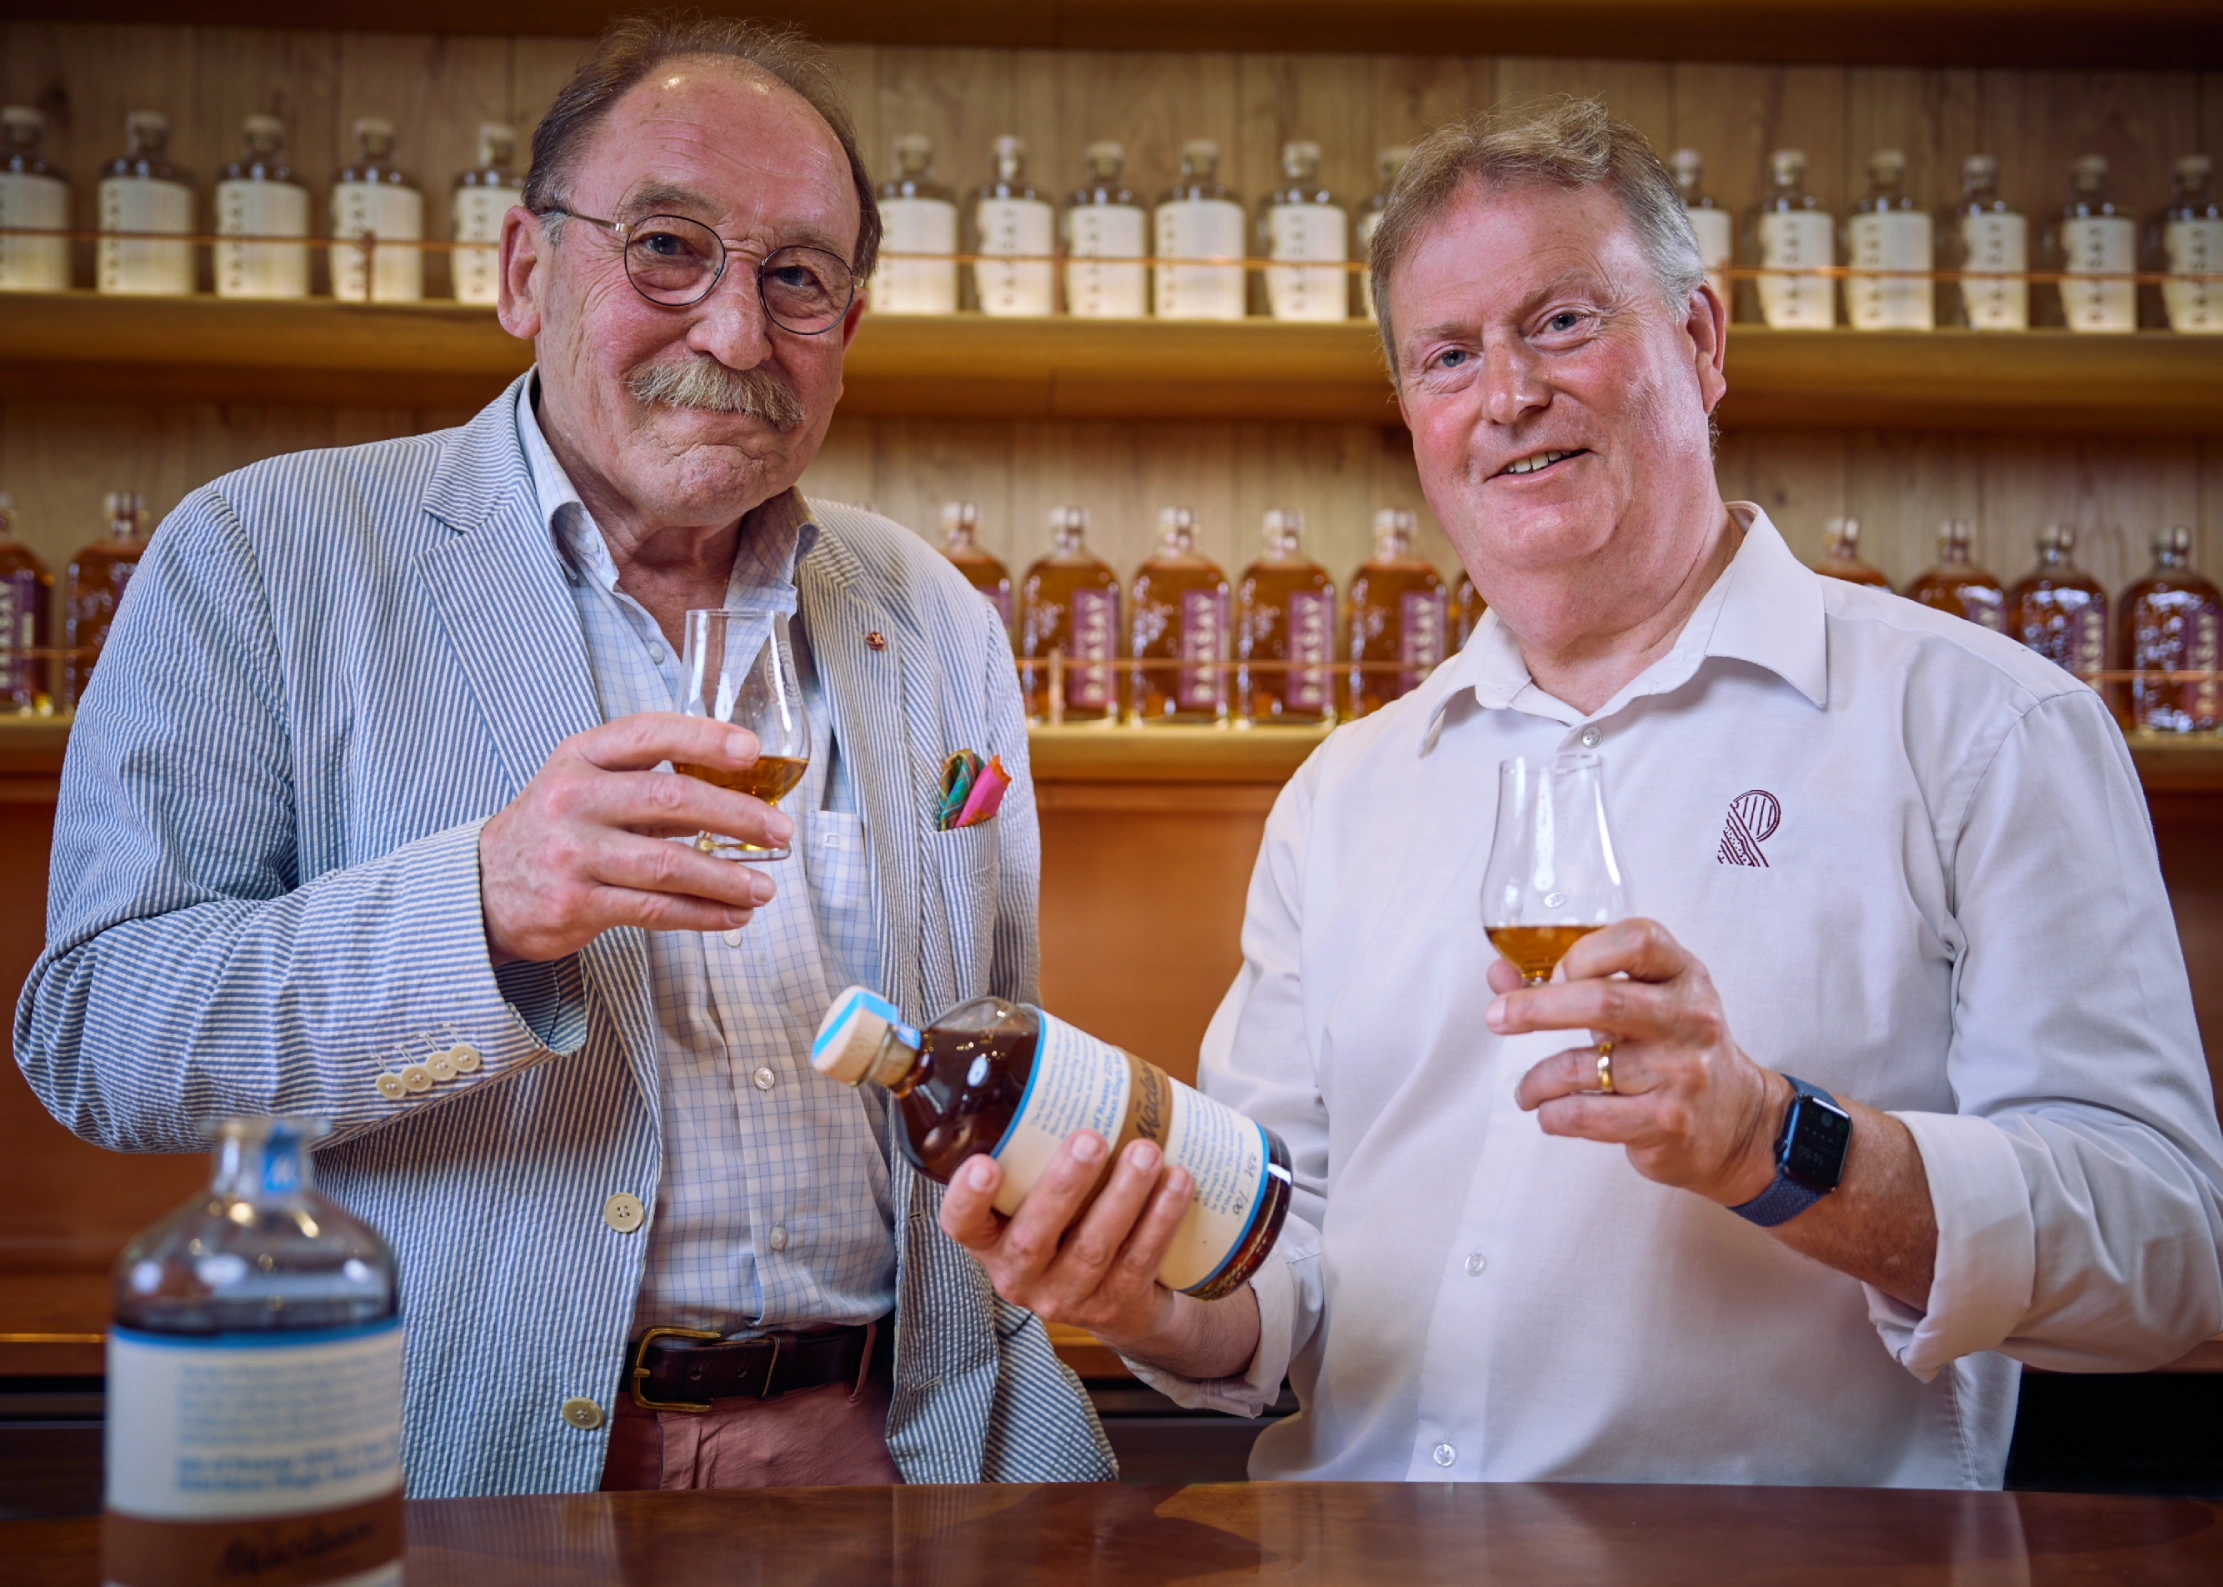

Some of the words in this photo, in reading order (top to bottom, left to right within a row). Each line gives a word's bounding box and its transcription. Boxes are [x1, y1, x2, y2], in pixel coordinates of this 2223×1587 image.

[1084, 594, 1107, 700] RAASAY
[1192, 594, 1215, 701] RAASAY
[1301, 595, 1324, 702] RAASAY
[1415, 596, 1436, 682] AASAY
